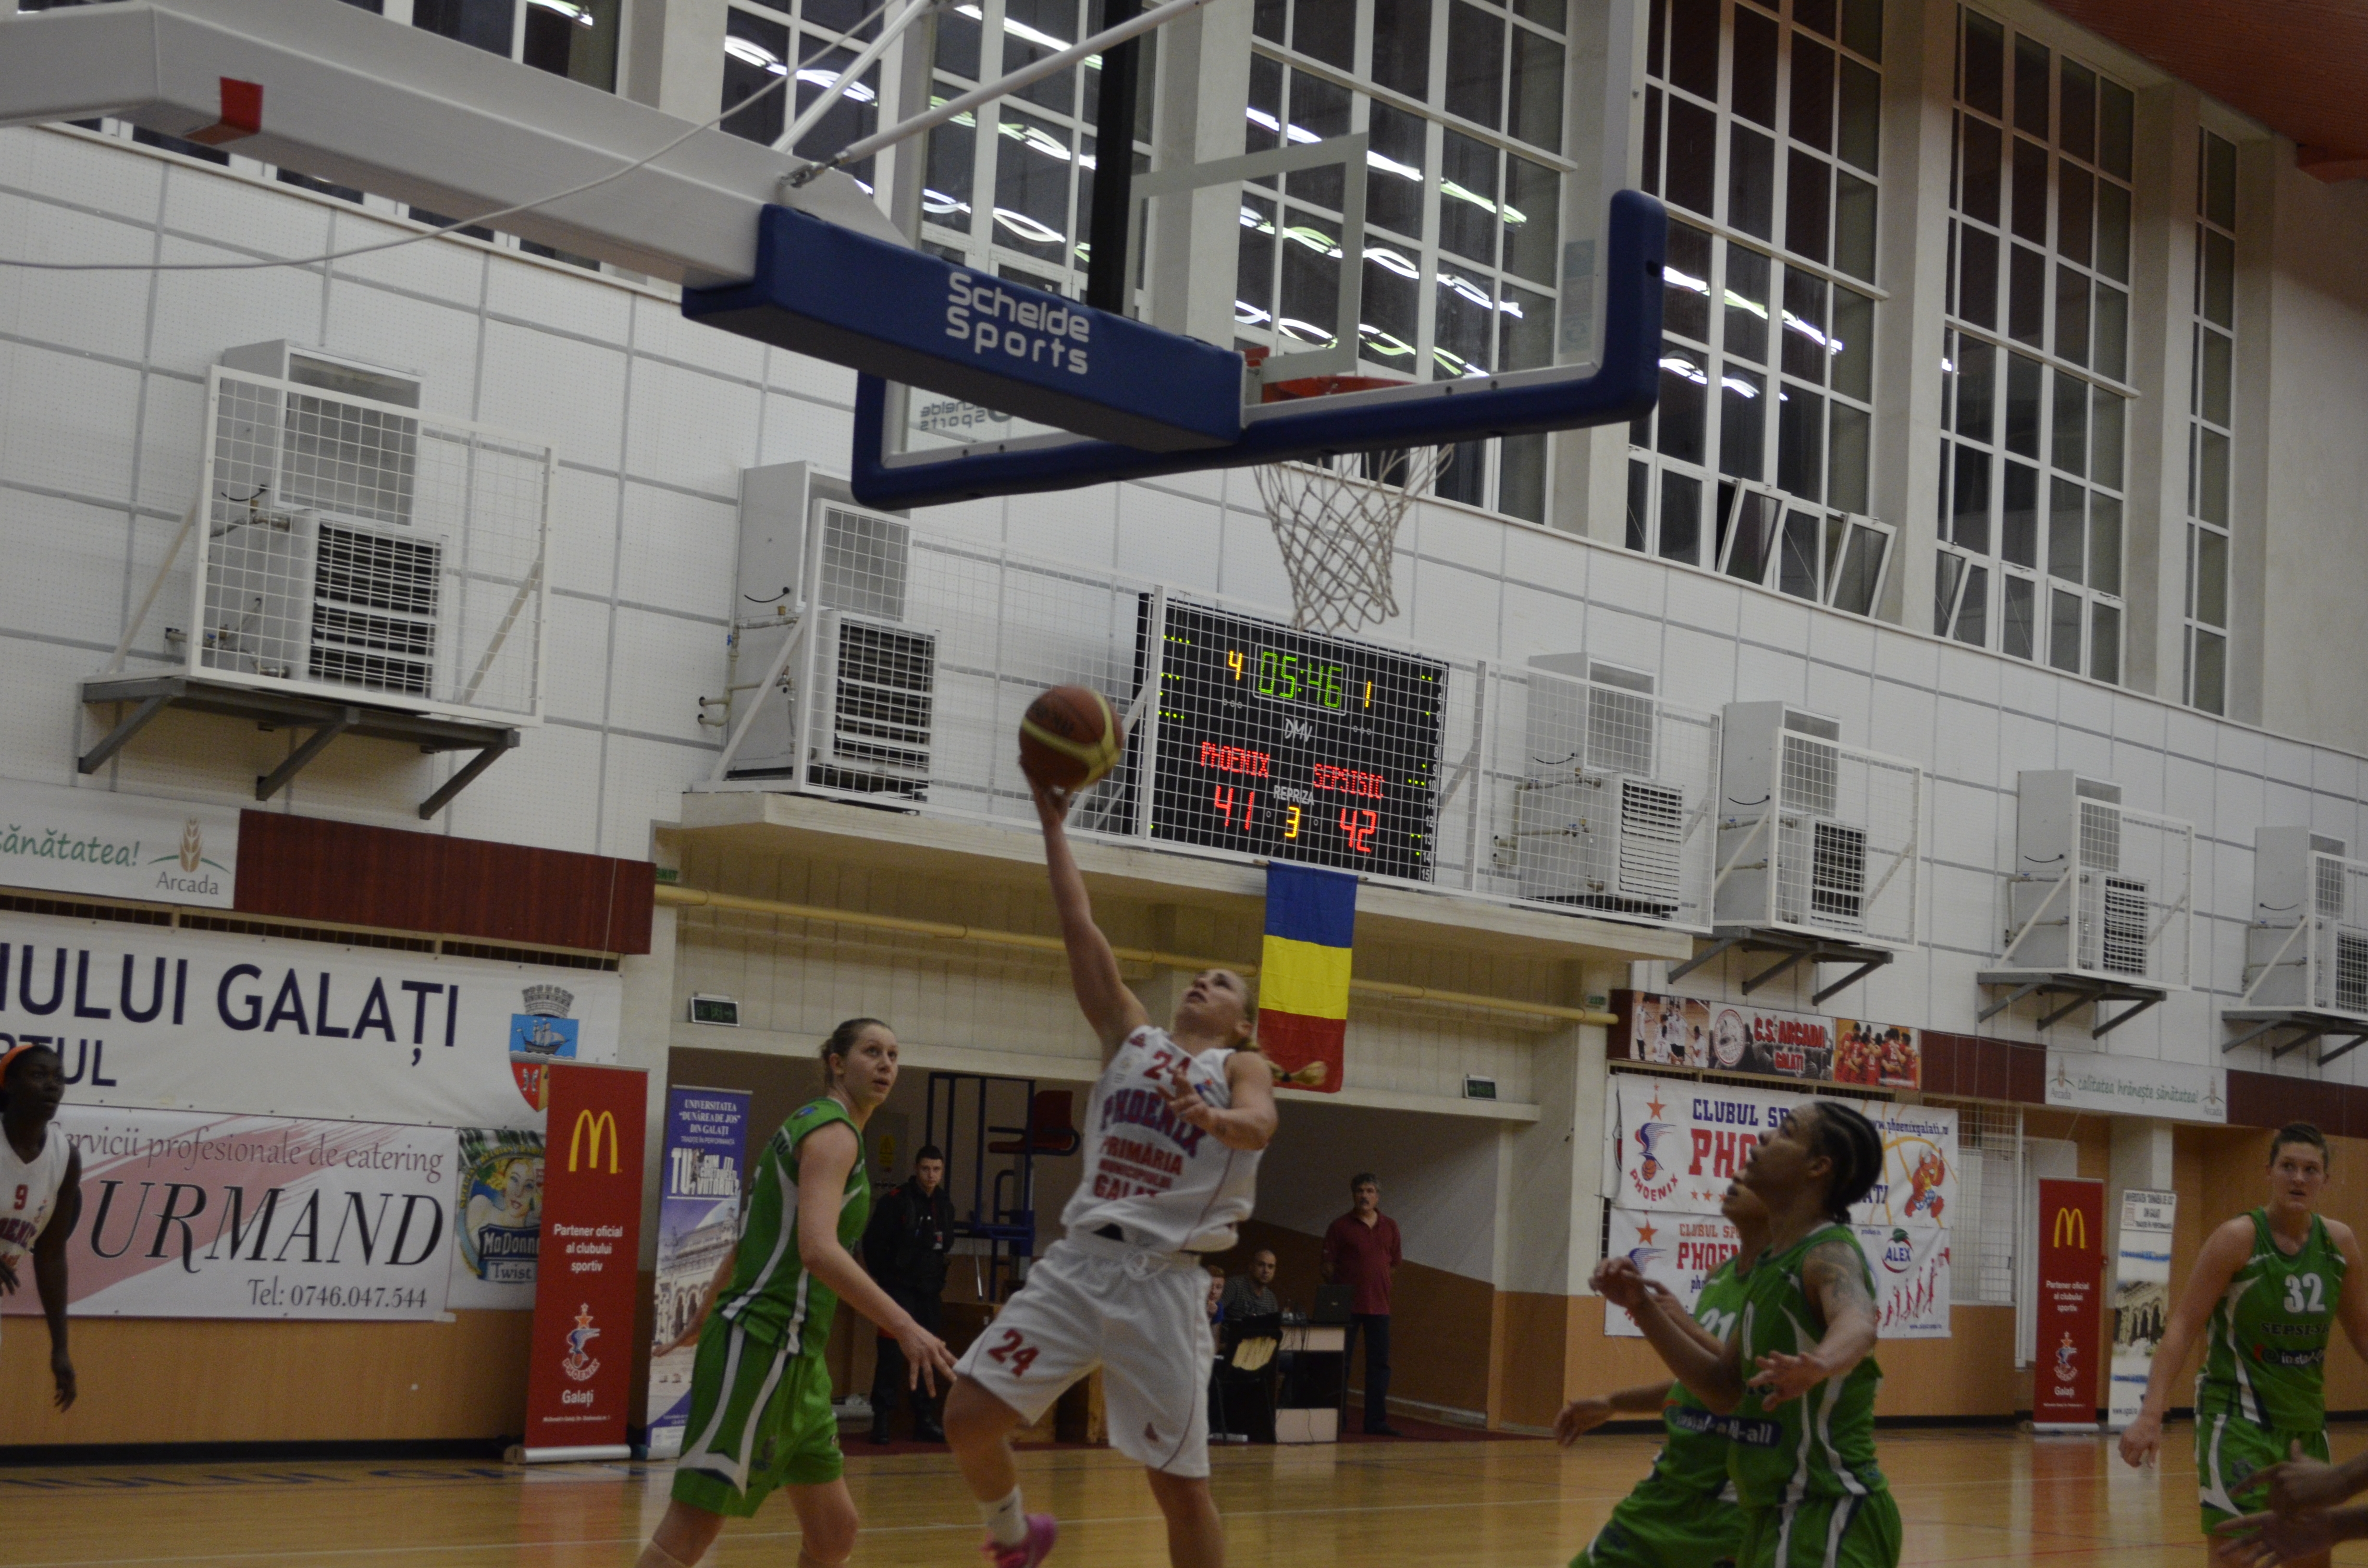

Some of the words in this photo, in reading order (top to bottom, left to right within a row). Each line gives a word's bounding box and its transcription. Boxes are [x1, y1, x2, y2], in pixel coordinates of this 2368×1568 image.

[948, 271, 1090, 343] Schelde
[945, 306, 1088, 375] Sports
[1258, 651, 1342, 709] 05:46
[1284, 718, 1312, 742] DMV
[1201, 741, 1270, 778] PHOENIX
[1273, 784, 1314, 806] REPRIZA
[1428, 779, 1436, 791] 10
[1214, 785, 1255, 831] 41
[1284, 806, 1300, 838] 3
[1426, 815, 1433, 828] 12
[1339, 808, 1377, 853] 42
[1423, 852, 1431, 863] 14
[156, 871, 219, 895] Arcada
[1421, 868, 1431, 882] 15
[216, 963, 459, 1067] GALAȚI
[1143, 1049, 1192, 1087] 24
[684, 1099, 737, 1112] UNIVERSITATEA
[1692, 1098, 1759, 1126] CLUBUL
[147, 1126, 305, 1171] profesionale
[310, 1134, 340, 1167] de
[345, 1139, 444, 1183] catering
[13, 1183, 29, 1211] 9
[1629, 1168, 1678, 1202] PHOENIX
[77, 1178, 444, 1274] URMAND
[554, 1224, 594, 1237] Partener
[596, 1225, 623, 1237] oficial
[1678, 1223, 1719, 1238] CLUBUL
[566, 1242, 575, 1253] al
[576, 1243, 613, 1255] clubului
[1884, 1247, 1912, 1262] ALEX
[491, 1262, 533, 1280] Twist
[571, 1261, 603, 1273] sportiv
[247, 1278, 284, 1307] Tel:
[290, 1283, 427, 1309] 0746.047.544
[2283, 1272, 2326, 1314] 32
[987, 1328, 1040, 1379] 24
